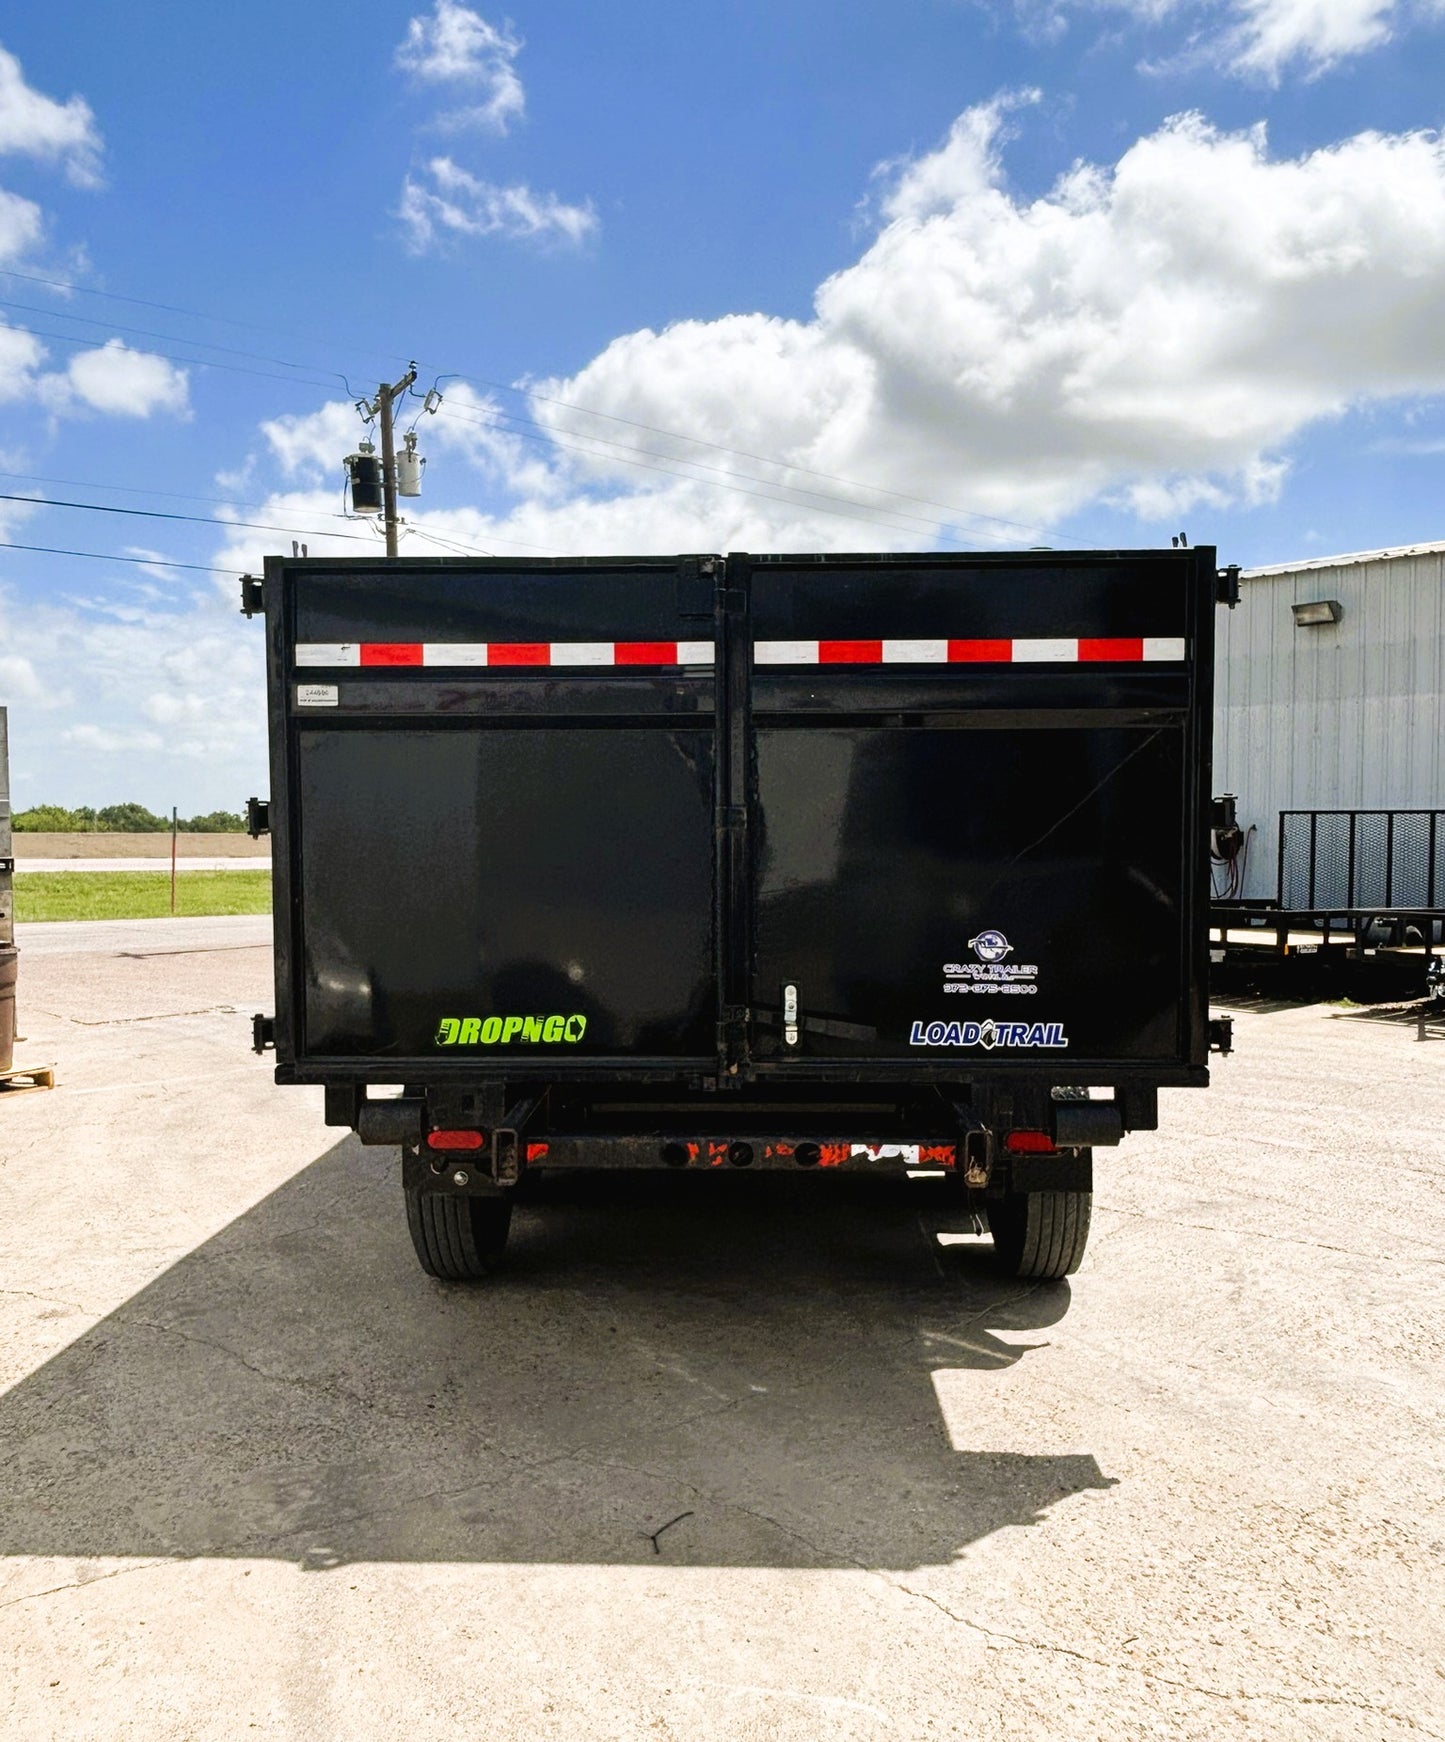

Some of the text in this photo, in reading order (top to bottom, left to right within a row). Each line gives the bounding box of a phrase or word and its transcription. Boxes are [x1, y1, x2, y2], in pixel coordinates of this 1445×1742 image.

[942, 964, 1039, 975] CRAZY TRAILER
[910, 1020, 1069, 1047] LOAD TRAIL
